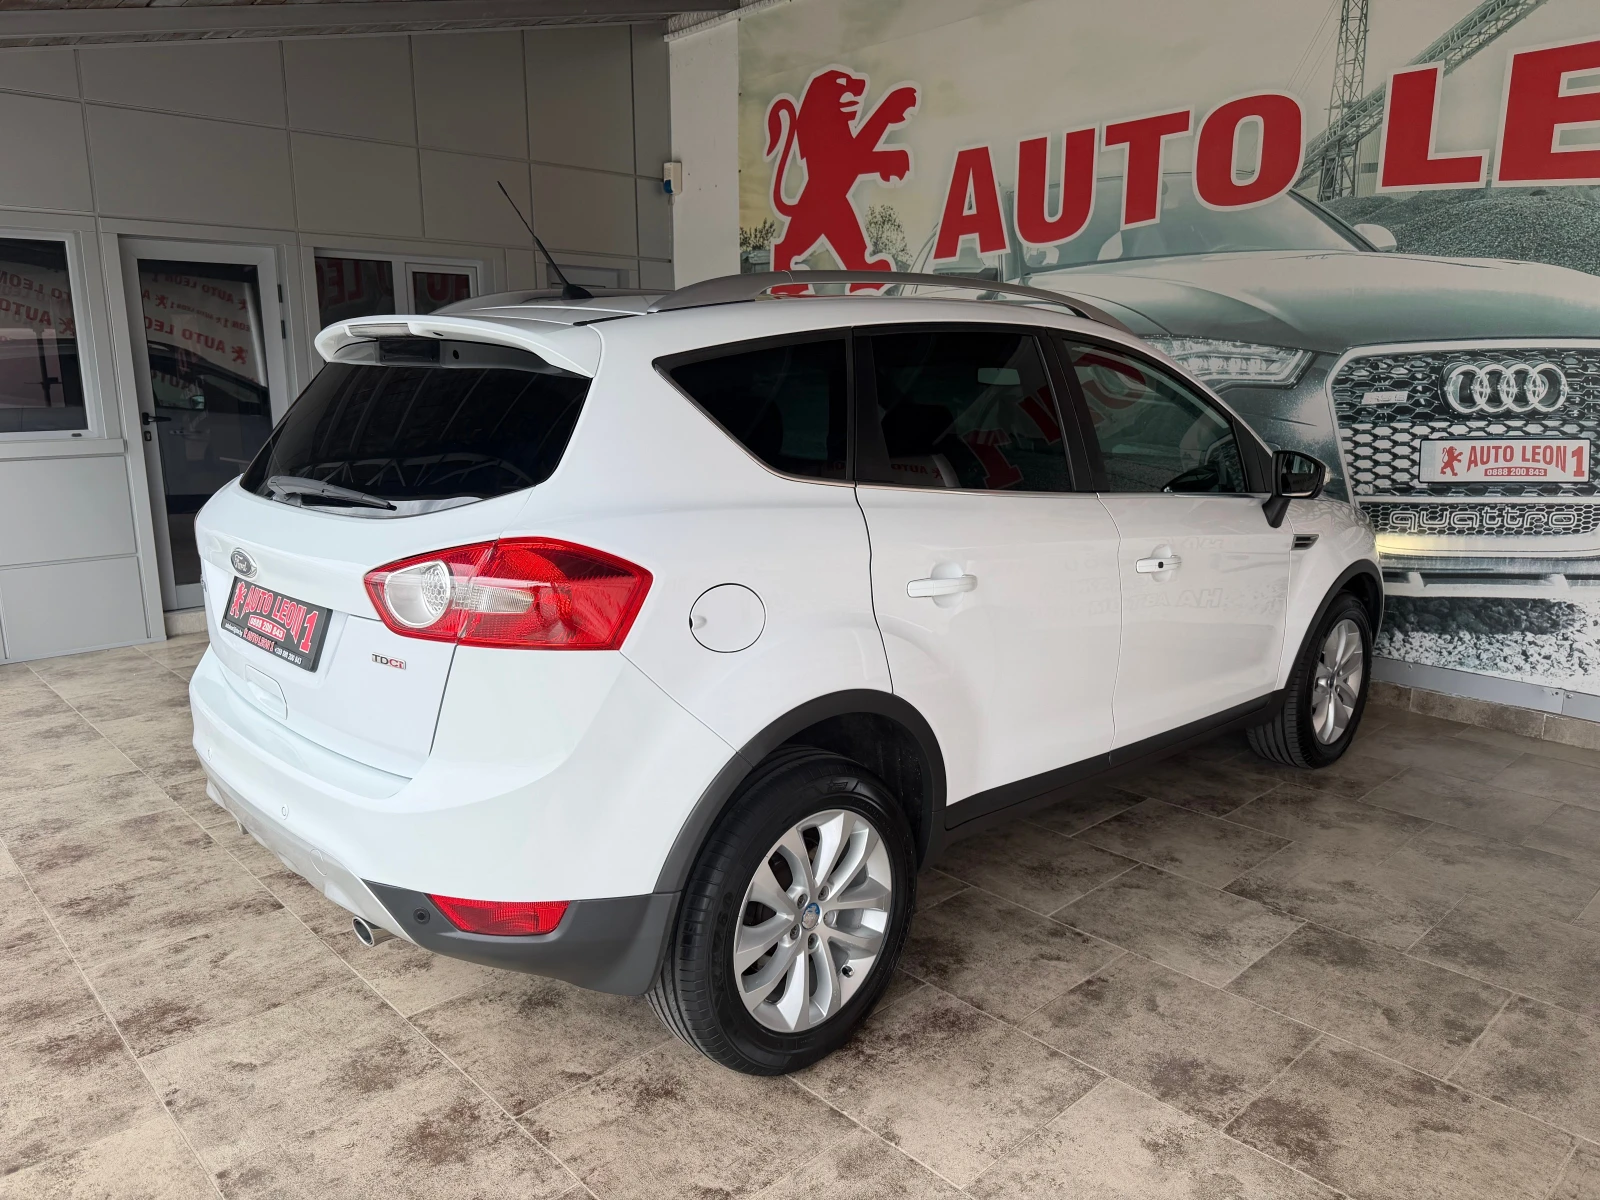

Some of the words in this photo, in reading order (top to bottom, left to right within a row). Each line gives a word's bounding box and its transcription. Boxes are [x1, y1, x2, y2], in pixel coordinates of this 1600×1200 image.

[932, 93, 1301, 260] AUTO
[1466, 445, 1514, 473] AUTO
[1521, 445, 1567, 474] LEON
[1571, 446, 1585, 477] 1
[1528, 468, 1545, 476] 843
[1389, 506, 1577, 533] quattro
[240, 585, 274, 619] AUTO
[271, 596, 307, 644] LEON
[299, 610, 319, 653] 1
[262, 621, 273, 633] 200
[272, 627, 284, 639] 843
